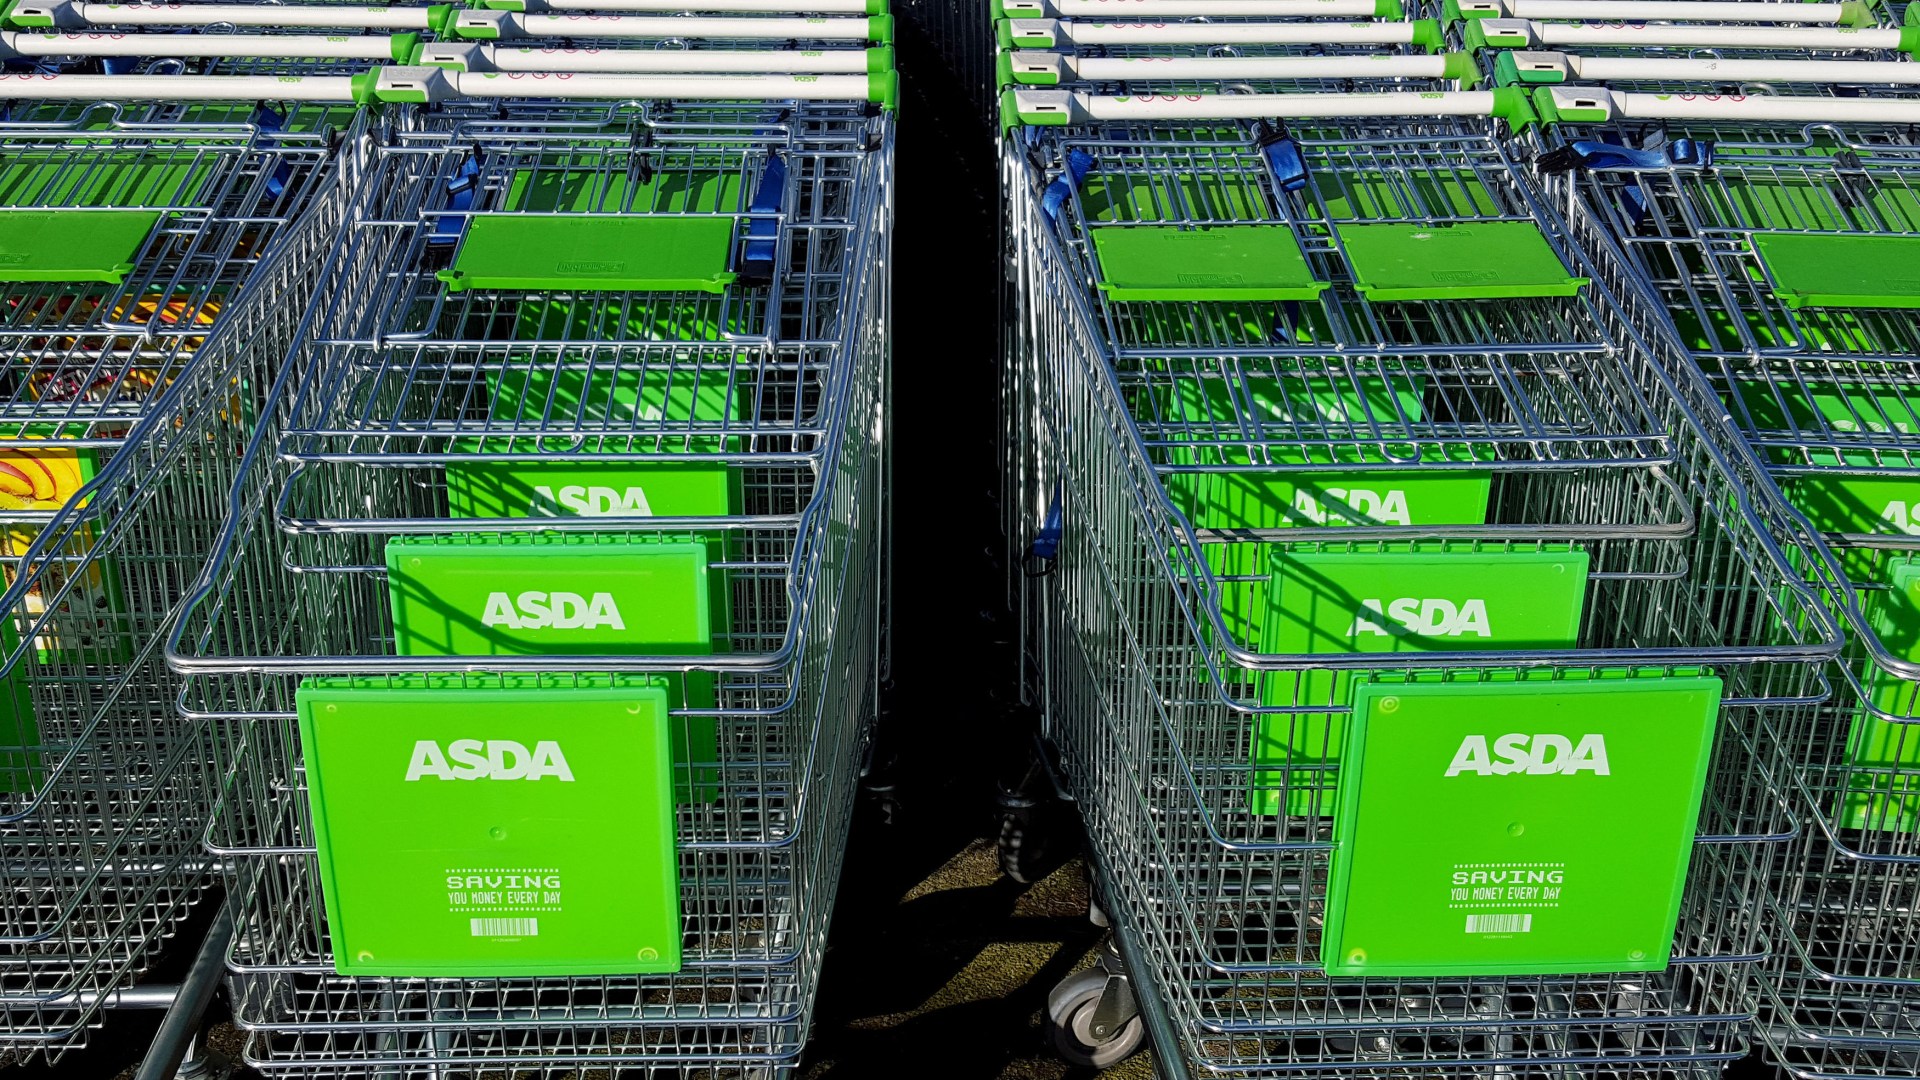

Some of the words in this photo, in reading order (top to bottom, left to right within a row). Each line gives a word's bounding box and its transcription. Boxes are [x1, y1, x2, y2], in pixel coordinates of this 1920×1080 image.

[527, 485, 654, 517] ASDA
[1282, 488, 1411, 525] ASDA
[481, 591, 626, 629] ASDA
[1345, 597, 1491, 637] ASDA
[404, 739, 575, 782] ASDA
[1443, 733, 1610, 777] ASDA
[446, 876, 561, 888] SAVING
[1451, 888, 1469, 900] YOU
[1472, 887, 1504, 900] MONEY
[1508, 886, 1540, 899] EVERY
[1543, 886, 1561, 899] DAY
[1452, 871, 1564, 884] SAVING
[448, 892, 467, 904] YOU
[471, 892, 503, 904] MONEY
[508, 891, 538, 904] EVERY
[543, 891, 561, 904] DAY
